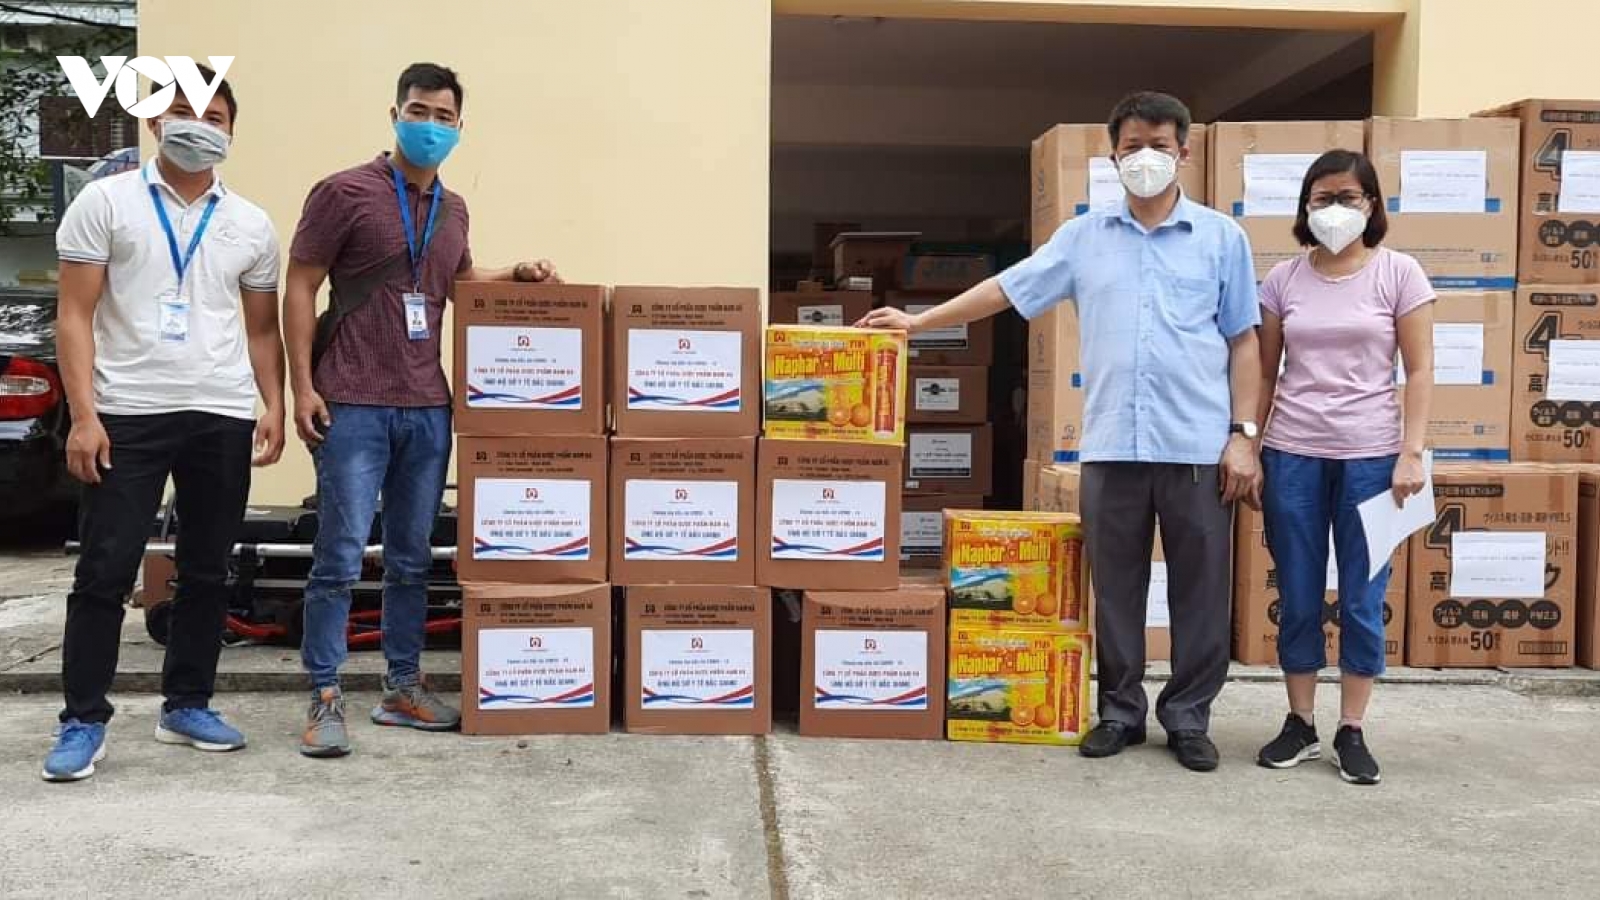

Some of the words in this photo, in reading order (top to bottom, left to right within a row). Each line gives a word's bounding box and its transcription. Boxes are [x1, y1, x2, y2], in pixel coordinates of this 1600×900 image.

[1533, 128, 1571, 181] 4
[1571, 250, 1591, 268] 50
[1524, 311, 1562, 362] 4
[775, 353, 819, 378] Naphar
[833, 350, 865, 373] Multi
[1563, 429, 1584, 448] 50
[1424, 503, 1466, 560] 4
[961, 542, 1006, 567] Naphar
[1019, 539, 1050, 562] Multi
[1471, 631, 1494, 651] 50
[958, 652, 1003, 677] Naphar
[1017, 650, 1049, 672] Multi
